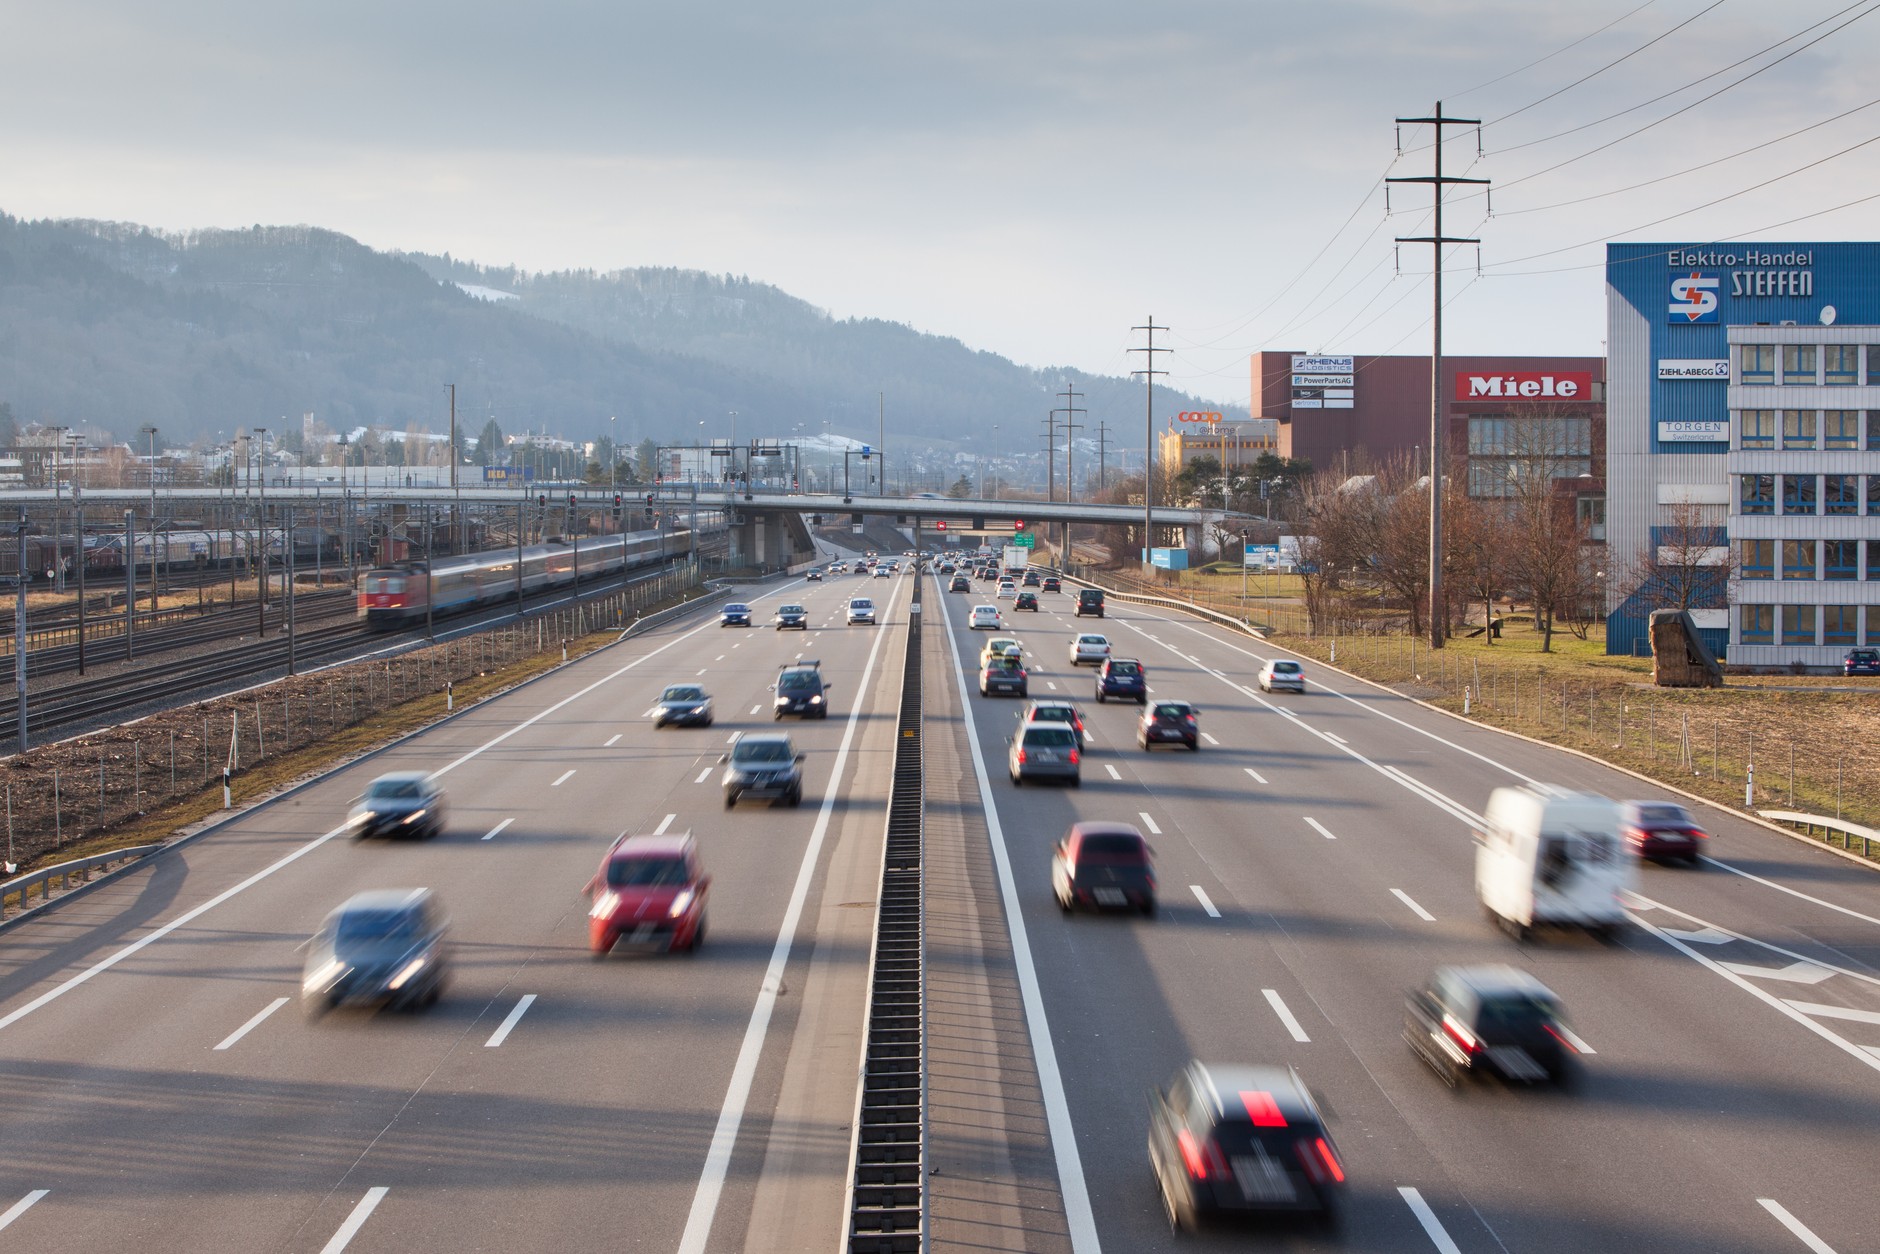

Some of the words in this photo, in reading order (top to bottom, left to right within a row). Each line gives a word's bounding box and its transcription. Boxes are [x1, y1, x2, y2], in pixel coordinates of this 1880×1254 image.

[1668, 250, 1812, 266] Elektro-Handel
[1731, 271, 1813, 296] STEFFEN
[1306, 358, 1352, 366] RHENUS
[1659, 368, 1714, 376] ZIEHL-ABEGG
[1468, 376, 1578, 397] Miele
[1178, 411, 1223, 425] coop
[1665, 422, 1721, 431] TORGEN
[1672, 433, 1715, 441] Switzerland
